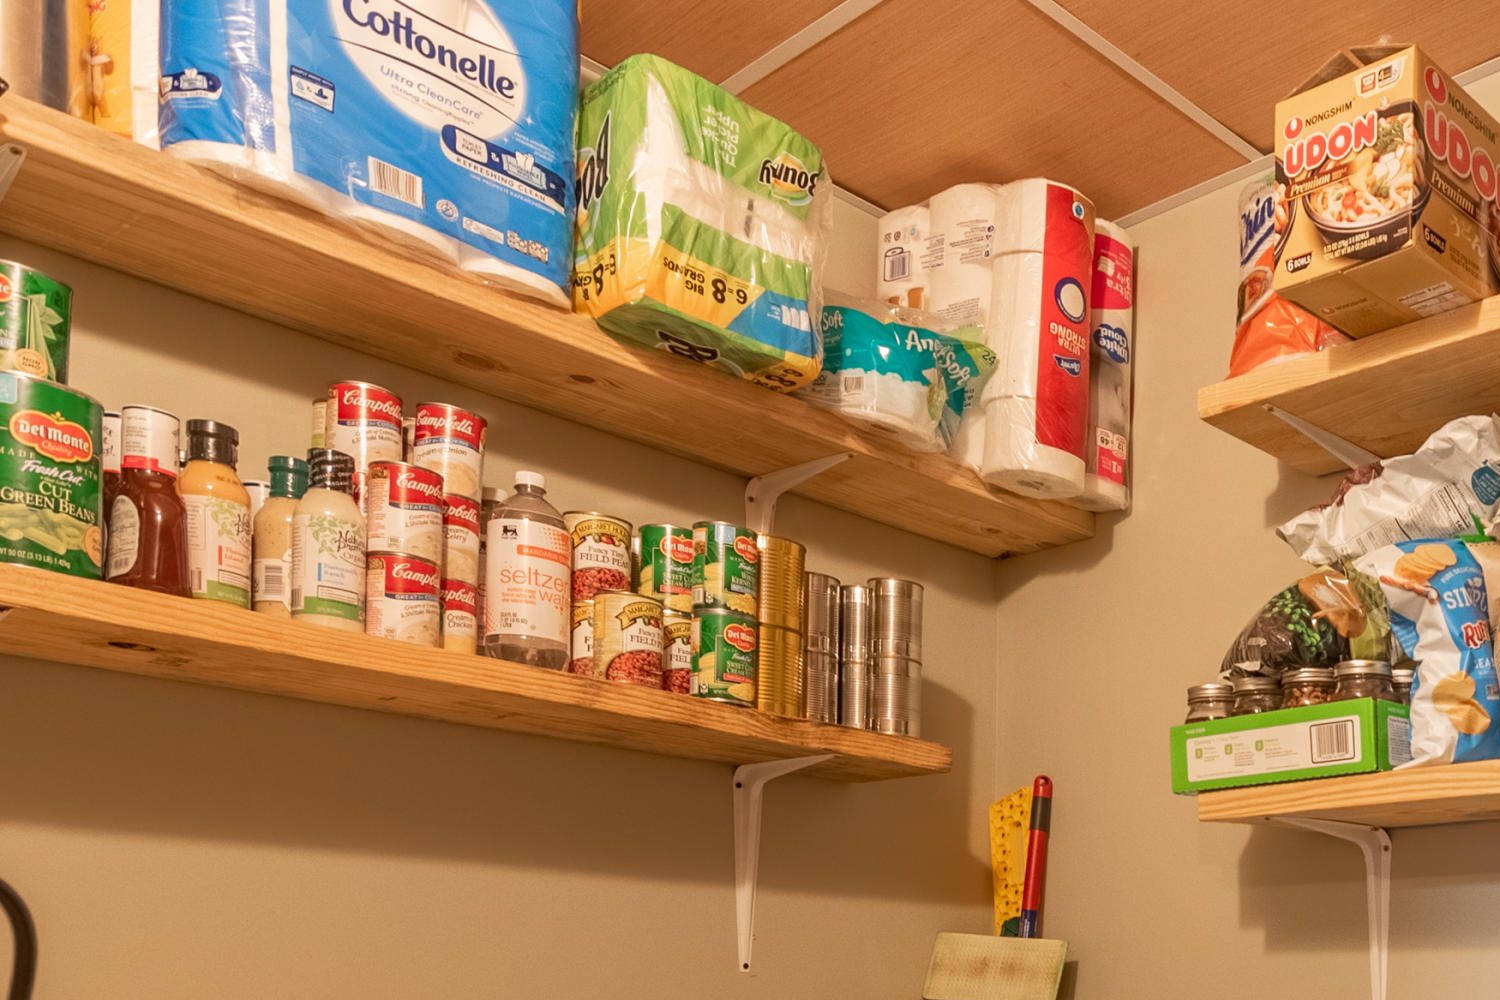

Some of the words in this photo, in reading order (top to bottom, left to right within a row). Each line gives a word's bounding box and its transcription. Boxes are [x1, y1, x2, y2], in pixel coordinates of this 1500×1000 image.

[342, 0, 515, 99] Cottonelle
[380, 65, 414, 88] Ultra
[416, 79, 484, 120] CleanCare
[1305, 100, 1353, 127] NONGSHIM
[1448, 92, 1496, 145] NONGSHIM
[461, 143, 483, 157] PAPER
[1283, 110, 1378, 178] UDON
[456, 156, 514, 188] REFRESHING
[517, 184, 547, 203] CLEAN
[1290, 172, 1331, 197] Premium
[1431, 167, 1475, 218] Premium
[1423, 227, 1431, 241] 6
[663, 257, 705, 283] GRANDS
[1287, 258, 1294, 272] 6
[685, 281, 704, 295] BIG
[822, 311, 843, 331] Soft
[1049, 323, 1088, 349] STRONG
[1099, 325, 1127, 346] Cloud
[1098, 336, 1128, 362] White
[17, 419, 46, 439] Del
[47, 428, 91, 453] Monte
[0, 486, 55, 509] GREEN
[59, 498, 96, 522] BEANS
[38, 480, 72, 502] CUT
[579, 553, 610, 564] FIELD
